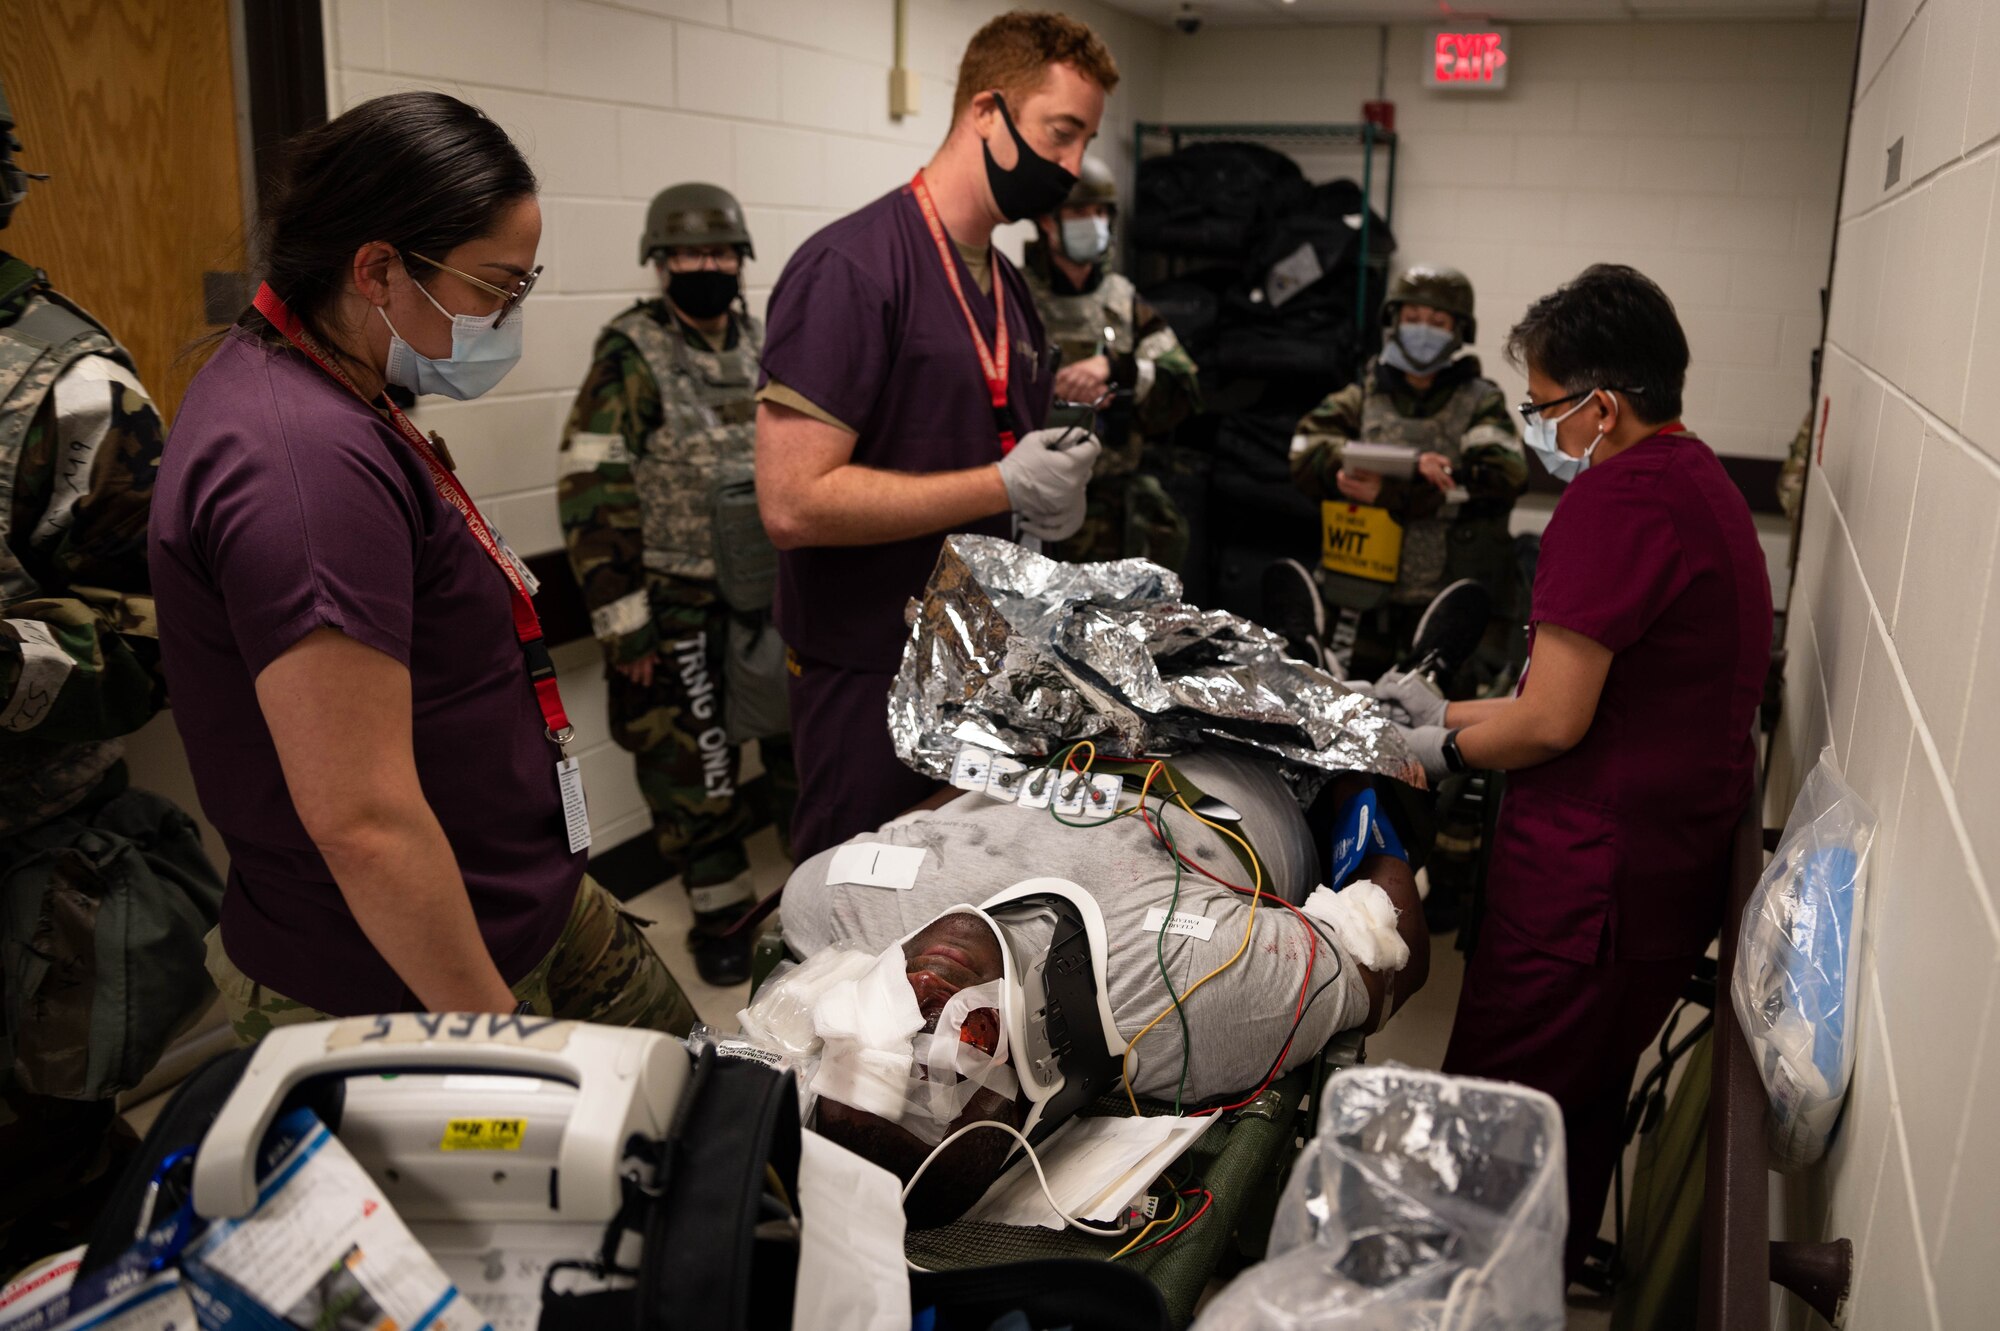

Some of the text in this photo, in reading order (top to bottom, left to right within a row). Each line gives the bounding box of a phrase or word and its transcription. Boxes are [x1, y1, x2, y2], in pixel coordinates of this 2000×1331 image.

[1435, 33, 1501, 81] EXIT
[438, 481, 471, 515] MISSION
[465, 512, 493, 549] MEDICAL
[1328, 525, 1370, 555] WIT
[674, 632, 735, 798] TRNG ONLY
[736, 1050, 778, 1064] SPECIMEN
